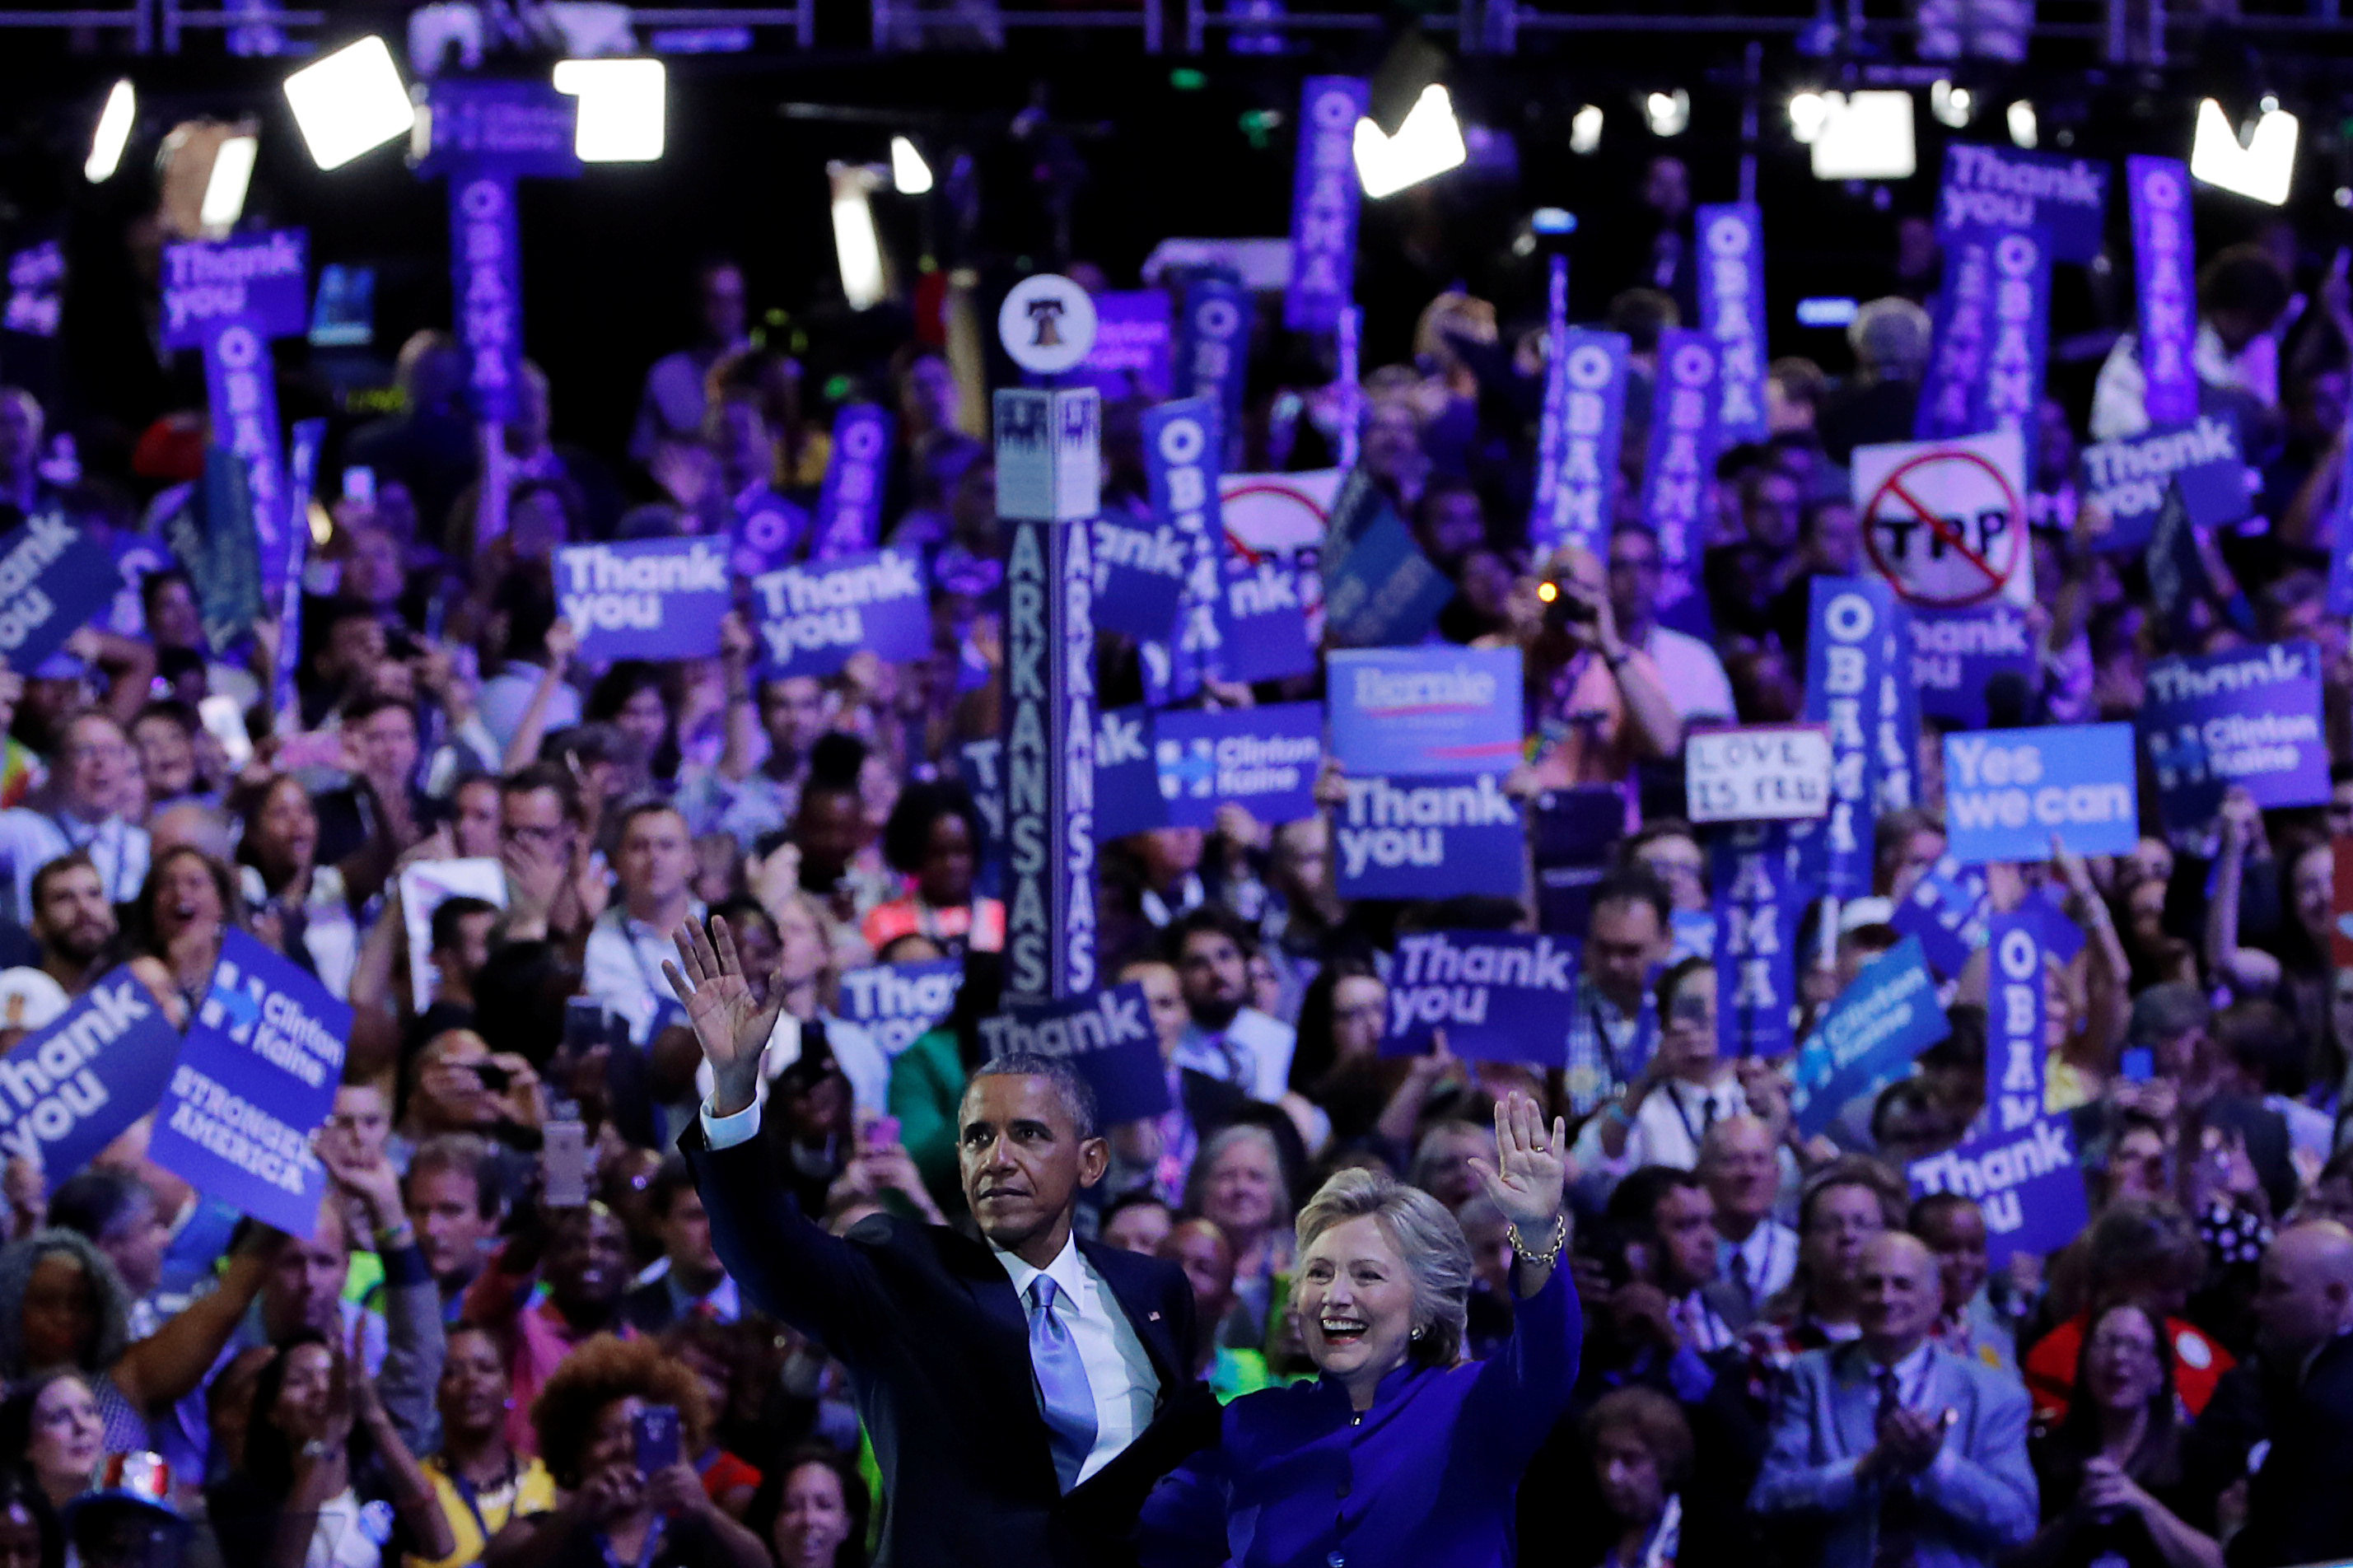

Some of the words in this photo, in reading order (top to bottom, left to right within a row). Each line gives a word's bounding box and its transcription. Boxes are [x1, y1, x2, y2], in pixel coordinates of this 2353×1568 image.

[1946, 143, 2103, 207] Thank
[1942, 188, 2035, 229] you
[167, 231, 302, 286] Thank
[165, 284, 245, 329] you
[2081, 414, 2235, 486] Thank
[0, 509, 80, 605] ank
[1092, 520, 1188, 578] ank
[1874, 510, 2007, 559] TPP
[559, 541, 731, 593] Thank
[751, 548, 922, 619] Thank
[0, 583, 56, 651] ou
[562, 593, 663, 642] you
[759, 607, 863, 666] you
[1006, 524, 1048, 992] ARKANSAS
[1064, 520, 1095, 993] ARKANSAS
[1948, 737, 2043, 787] Yes
[1344, 772, 1521, 827] Thank
[1949, 791, 2031, 829] we
[2033, 784, 2133, 824] can
[1337, 826, 1445, 878] you
[1397, 930, 1574, 992] Thank
[840, 964, 965, 1021] Tha
[1389, 985, 1490, 1038] you
[0, 981, 151, 1125] hank
[262, 991, 346, 1069] Clinton
[978, 989, 1149, 1057] Thank
[1, 1069, 110, 1173] you
[169, 1101, 306, 1196] AMERICA
[1909, 1122, 2074, 1197] Thank
